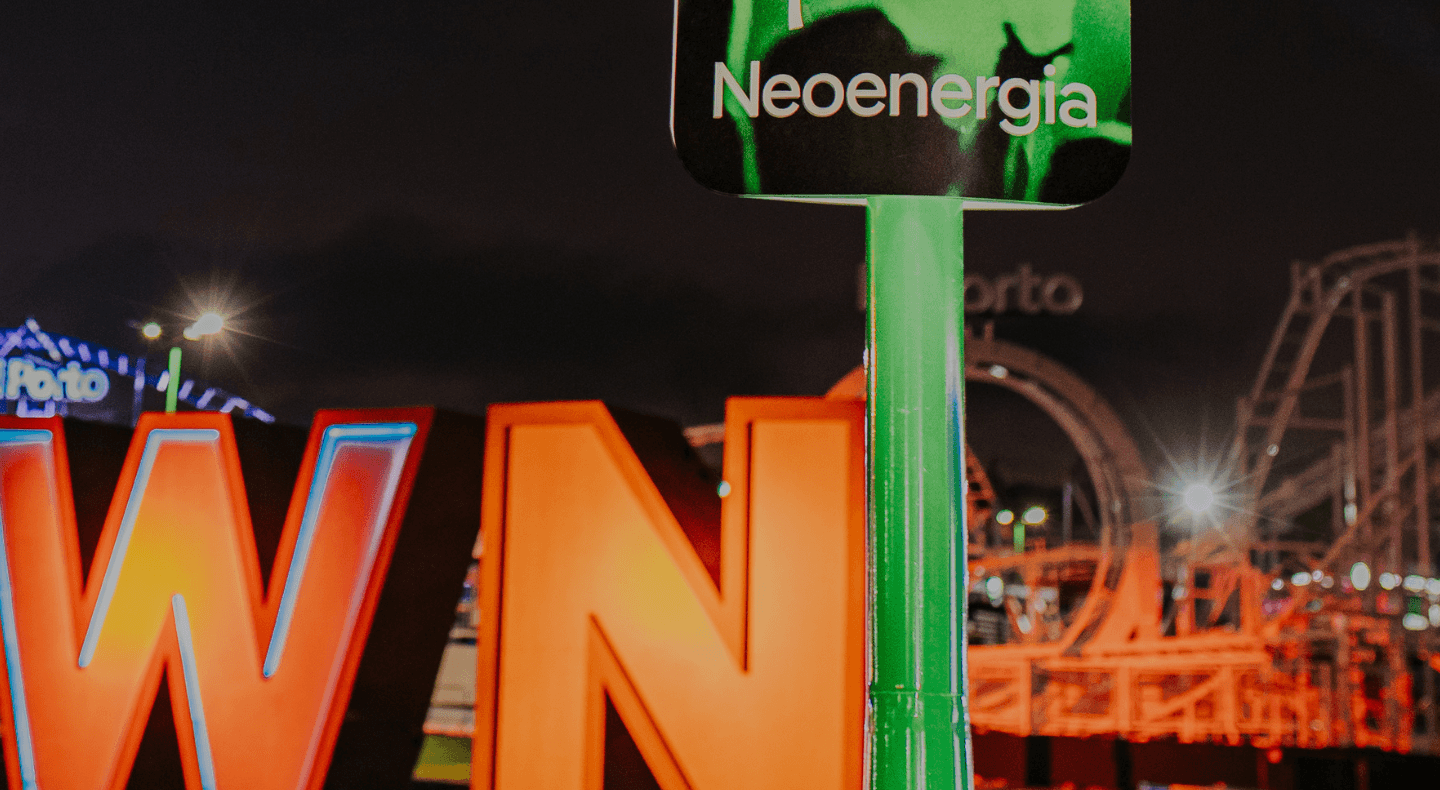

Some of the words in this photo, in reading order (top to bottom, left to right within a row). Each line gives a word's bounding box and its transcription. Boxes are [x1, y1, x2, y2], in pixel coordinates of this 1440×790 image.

[712, 60, 1098, 136] Neoenergia
[963, 263, 1084, 315] orto
[6, 357, 110, 402] Porto
